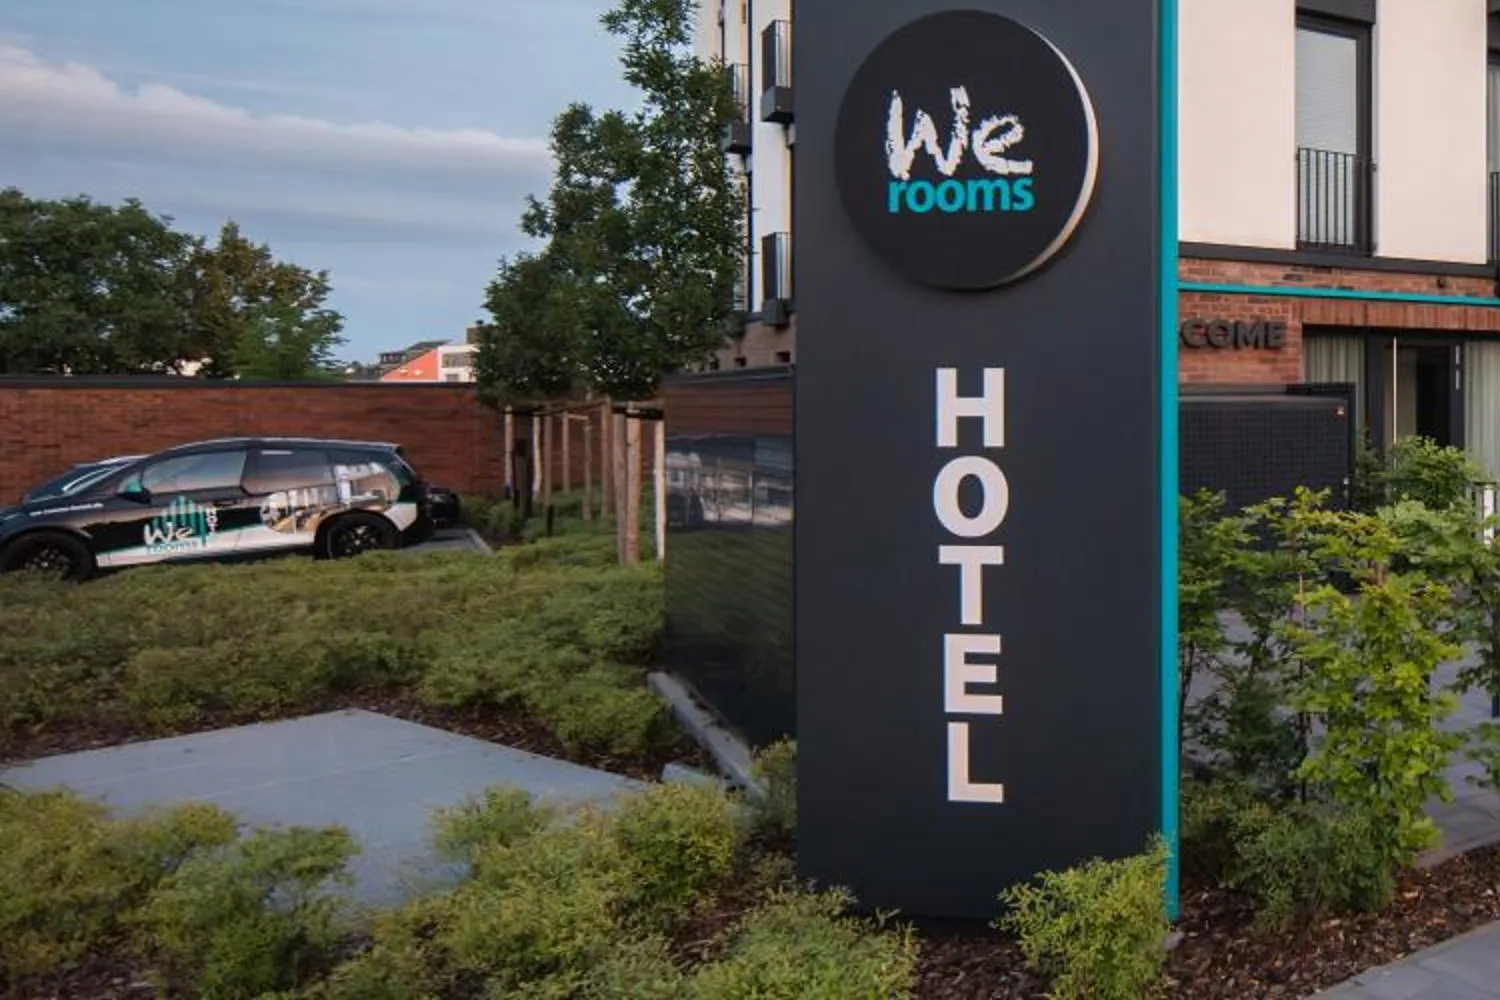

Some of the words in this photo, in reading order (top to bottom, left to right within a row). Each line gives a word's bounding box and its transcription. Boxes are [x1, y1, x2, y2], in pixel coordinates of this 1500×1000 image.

[885, 85, 1034, 181] We
[887, 175, 1035, 214] rooms
[1178, 317, 1287, 351] COME
[933, 367, 1009, 804] HOTEL
